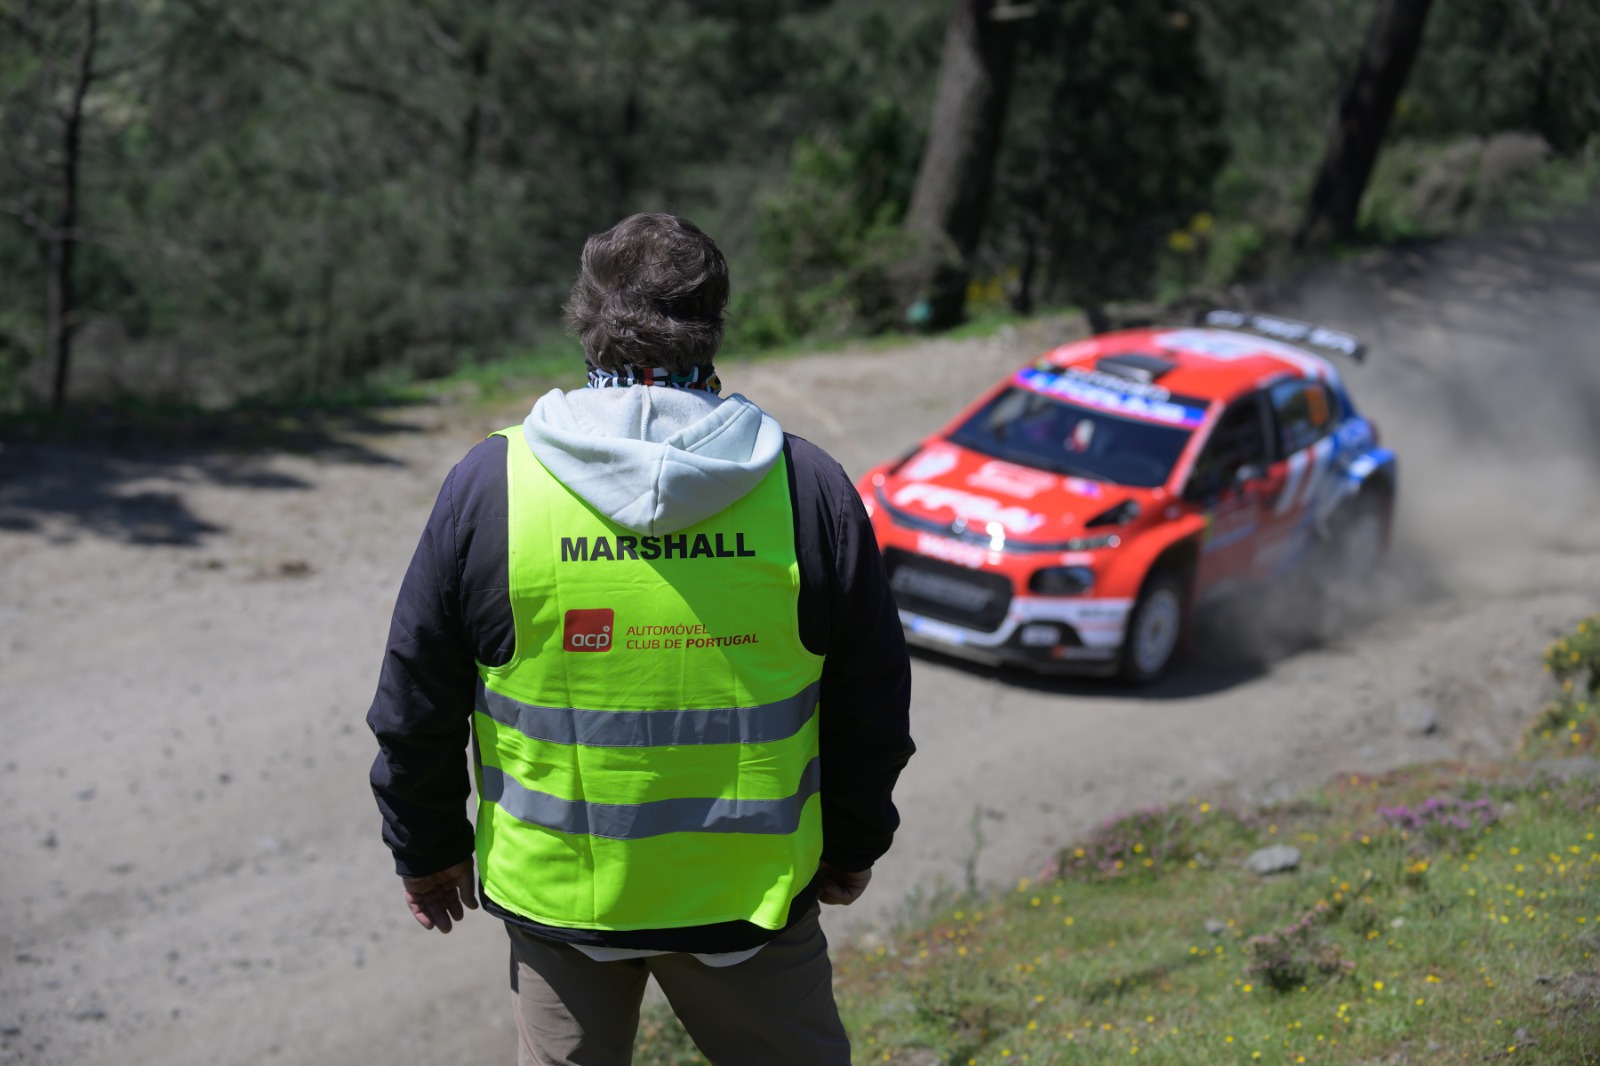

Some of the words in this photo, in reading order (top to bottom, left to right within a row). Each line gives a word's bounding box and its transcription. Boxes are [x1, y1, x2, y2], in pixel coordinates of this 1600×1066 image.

[560, 533, 756, 562] MARSHALL
[626, 623, 709, 636] AUTOMÓVEL
[571, 633, 610, 650] acp
[626, 638, 660, 650] CLUB
[664, 638, 682, 649] DE
[686, 633, 759, 648] PORTUGAL
